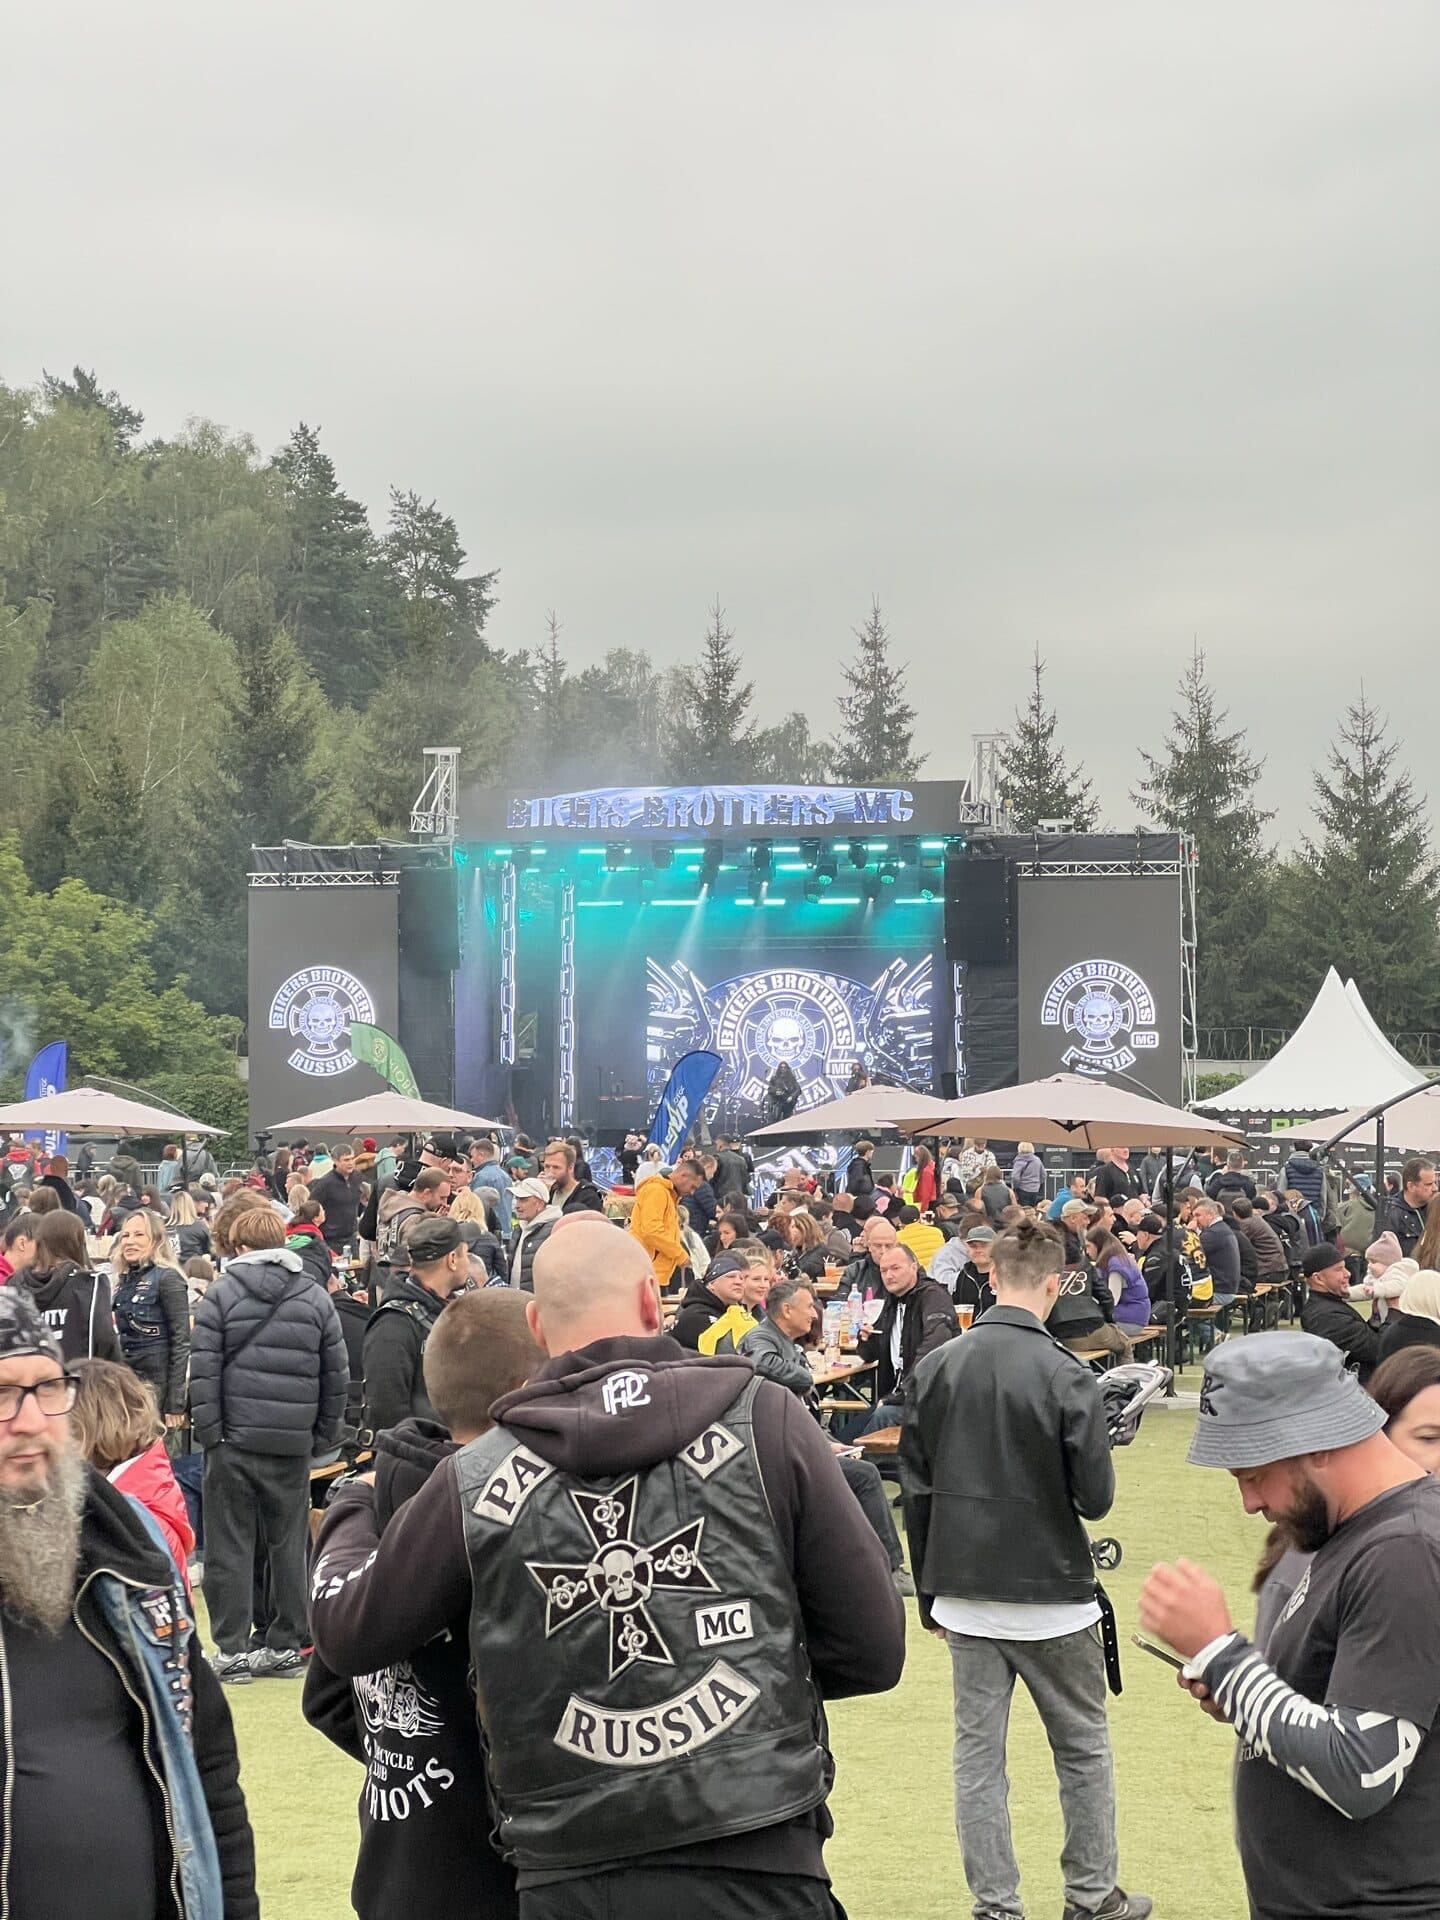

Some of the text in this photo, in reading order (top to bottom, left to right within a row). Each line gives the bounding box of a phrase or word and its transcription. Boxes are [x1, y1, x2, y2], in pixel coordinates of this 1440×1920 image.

[507, 790, 913, 829] BIKERS BROTHERS MC
[272, 971, 309, 1026] BIKERS
[310, 969, 372, 1024] BROTHERS
[721, 973, 851, 1047] BIKERS BROTHERS
[1044, 966, 1084, 1022] BIKERS
[1085, 963, 1153, 1022] BROTHERS
[293, 1052, 355, 1074] RUSSIA
[1135, 1034, 1155, 1046] MC
[701, 1608, 747, 1641] MC
[568, 1678, 748, 1758] RUSSIA
